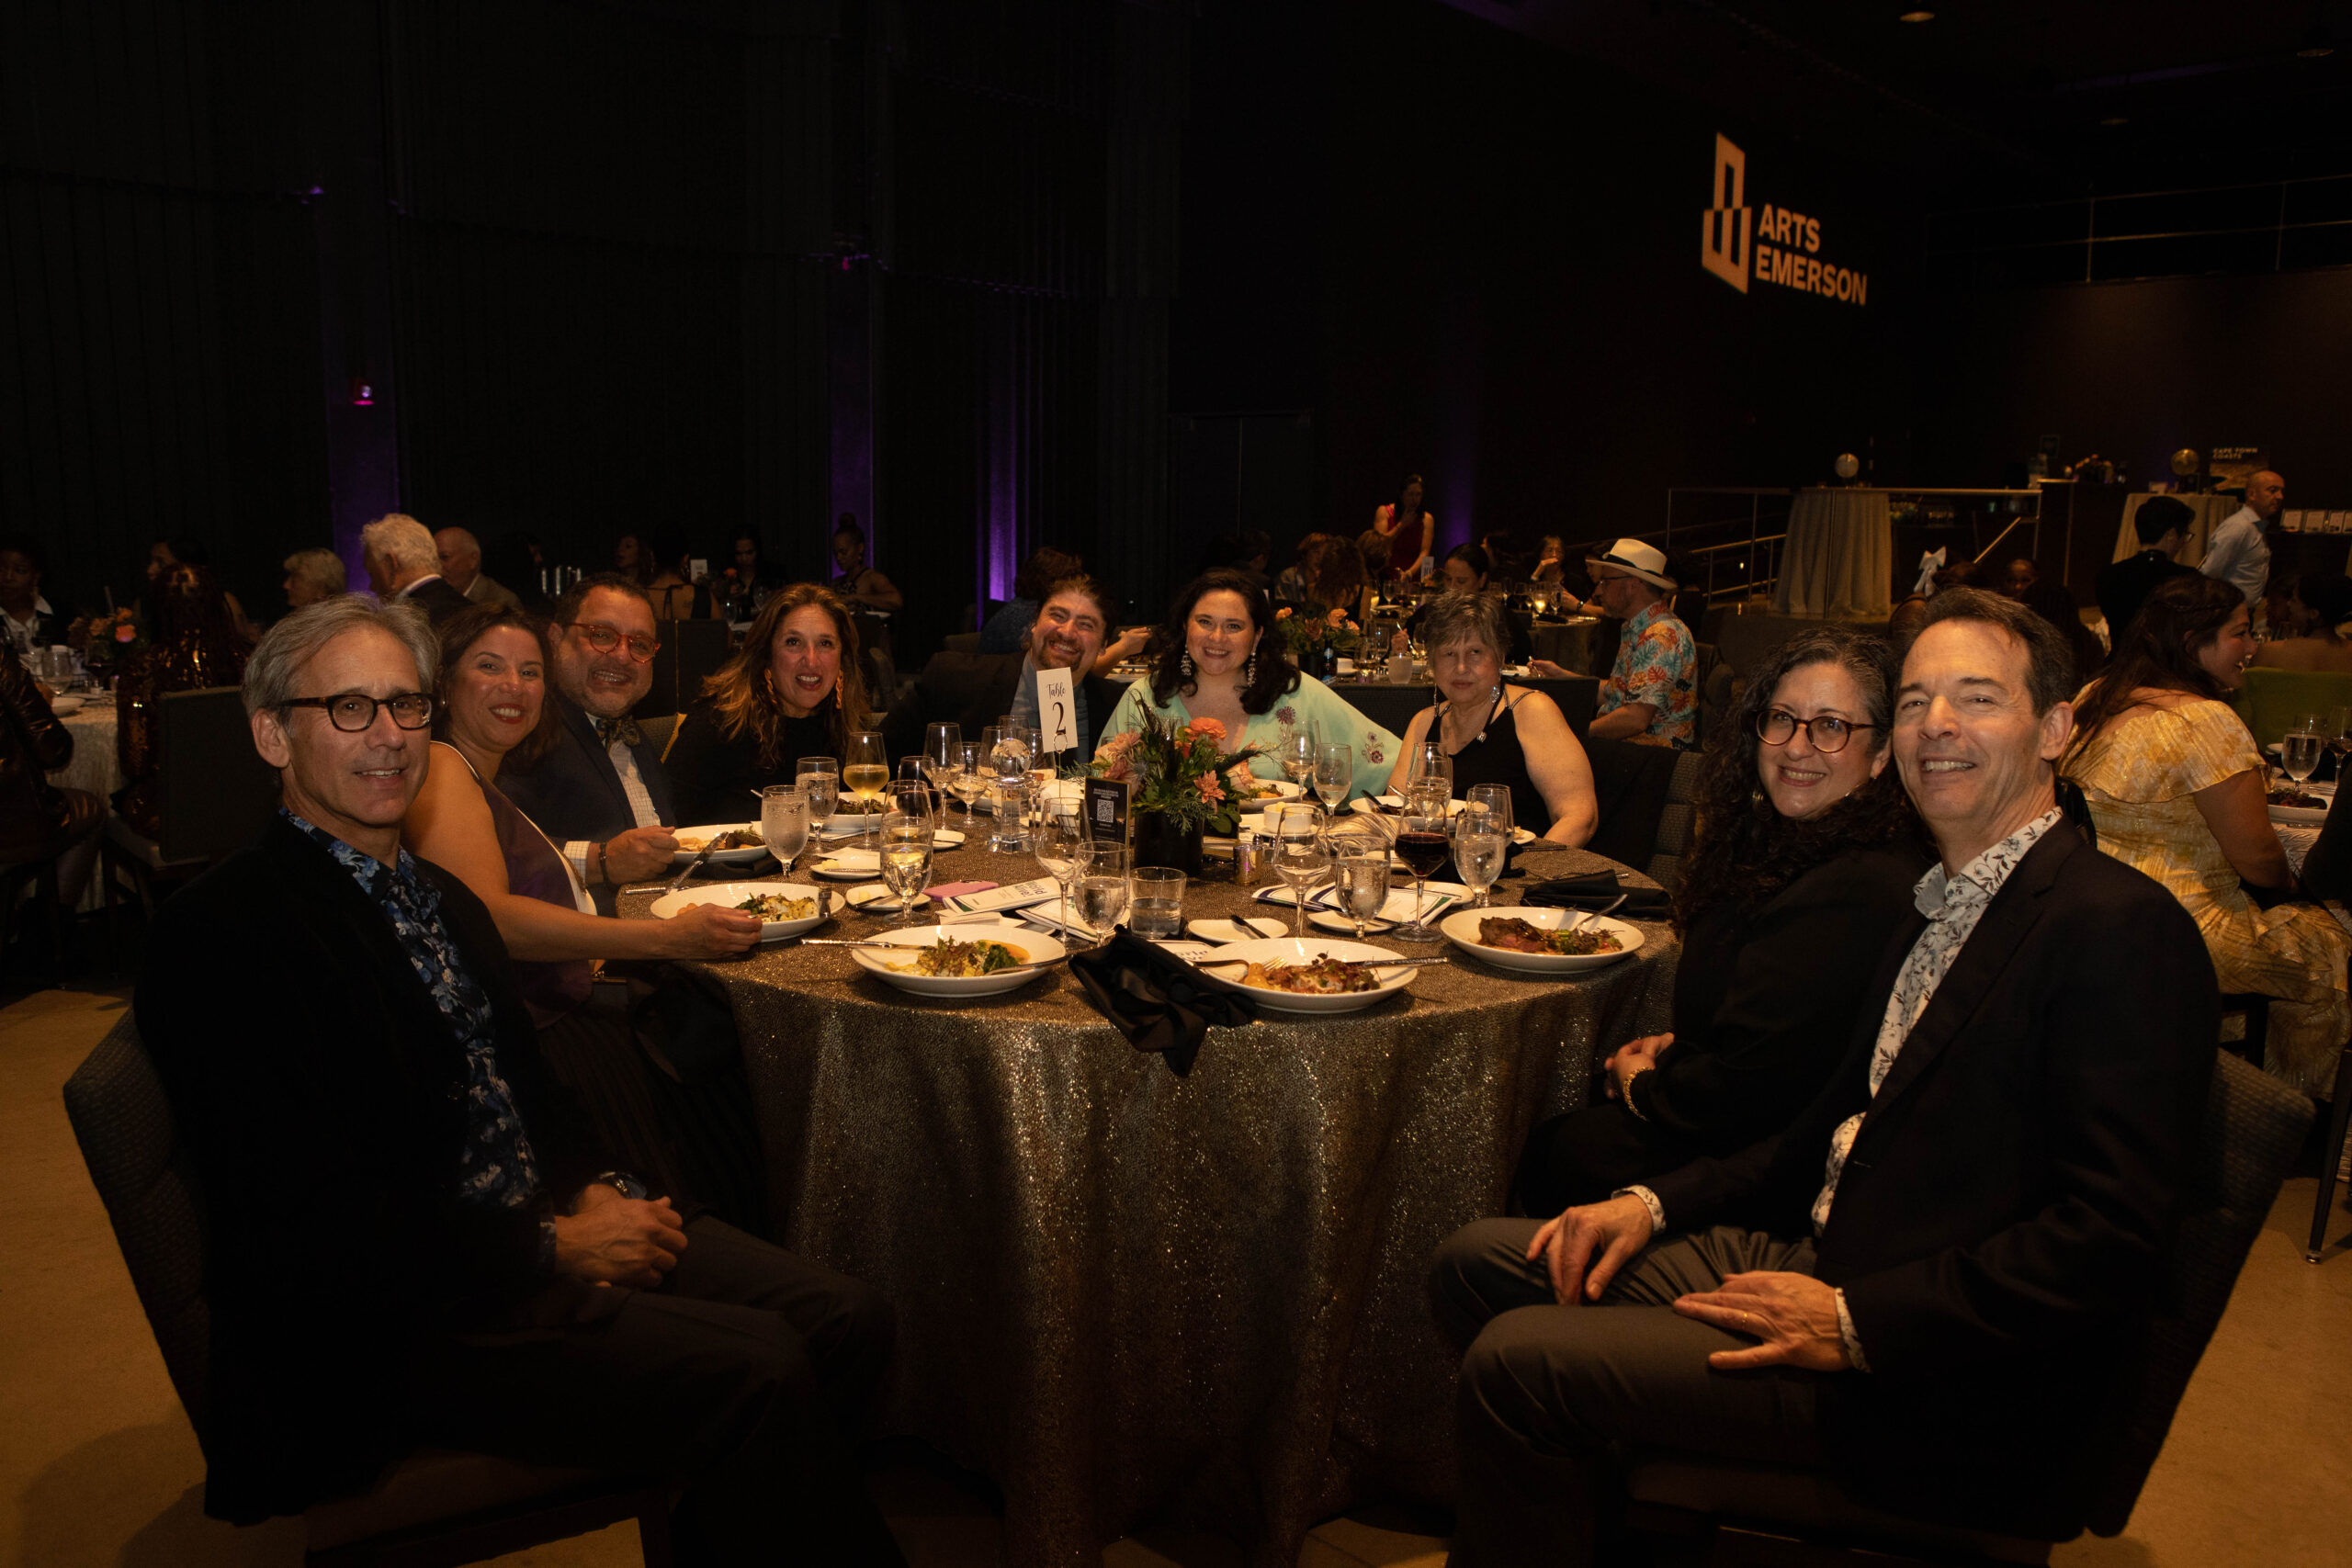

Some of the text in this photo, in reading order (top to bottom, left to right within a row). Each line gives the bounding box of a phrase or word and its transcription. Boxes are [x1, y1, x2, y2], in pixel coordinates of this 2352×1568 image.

[1758, 203, 1821, 253] ARTS
[1756, 243, 1868, 307] EMERSON
[1046, 682, 1066, 699] Table
[1052, 702, 1067, 735] 2
